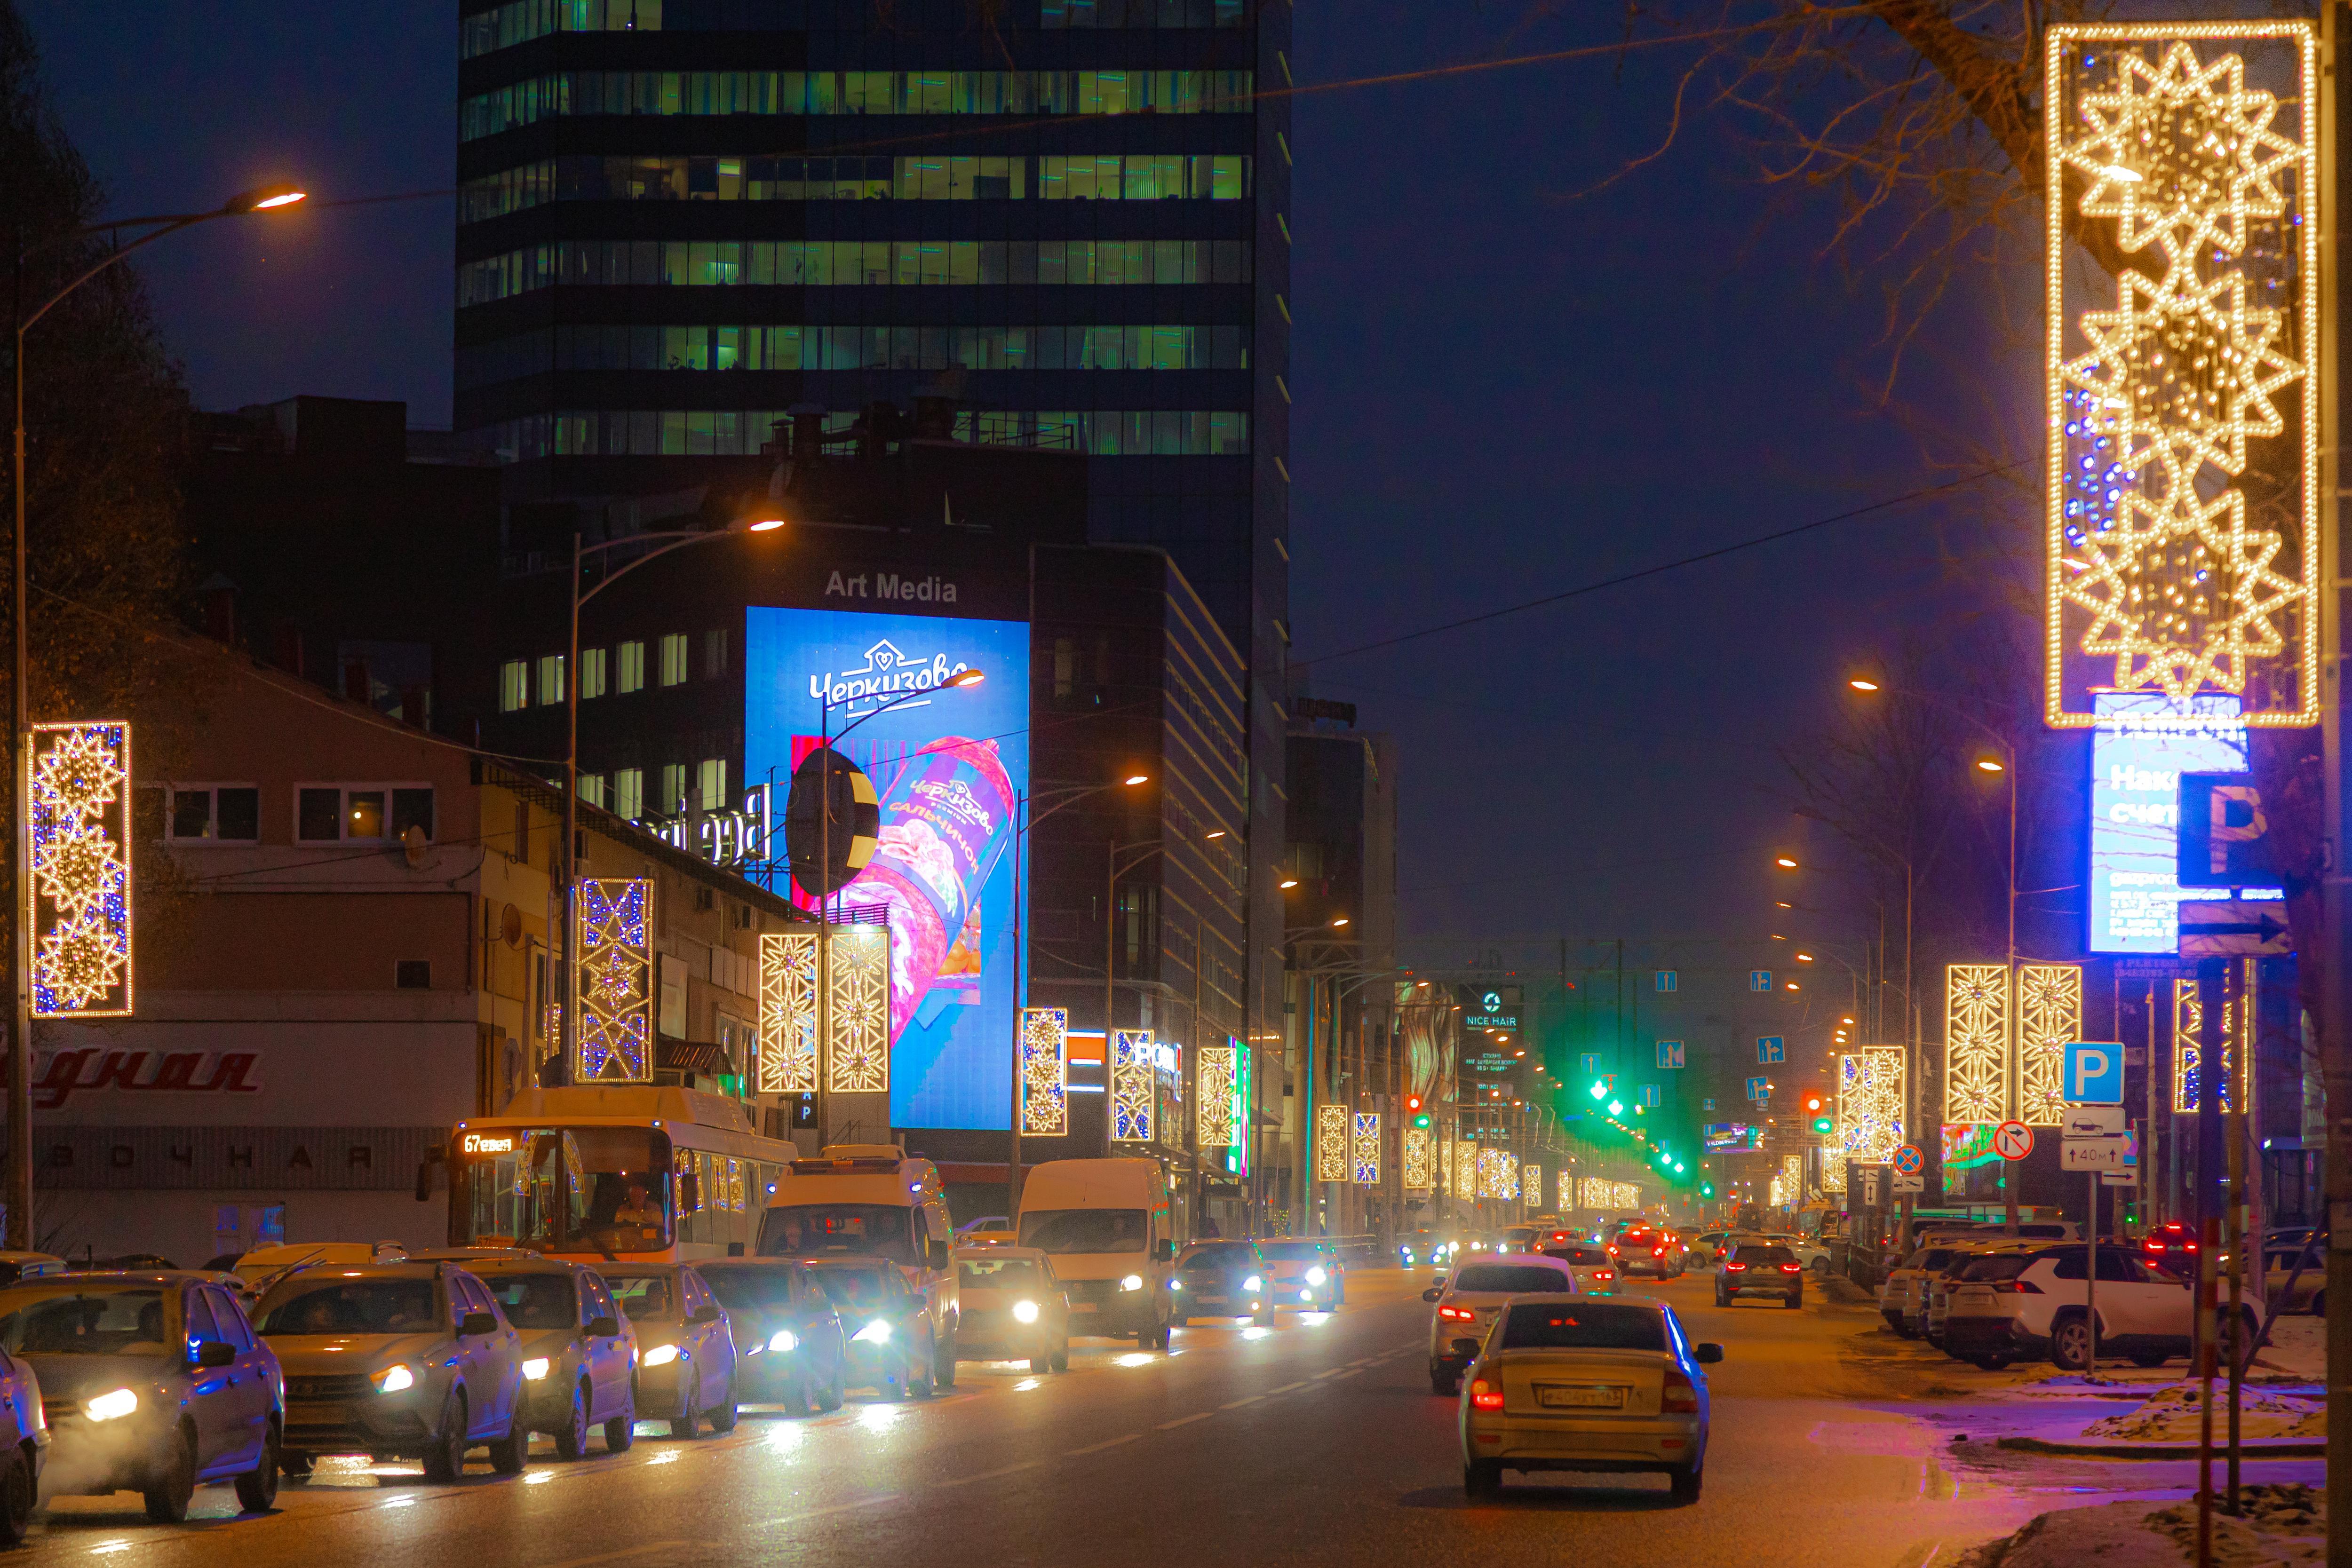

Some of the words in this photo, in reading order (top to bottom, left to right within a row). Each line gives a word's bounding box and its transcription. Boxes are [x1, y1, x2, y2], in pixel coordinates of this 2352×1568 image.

[825, 570, 867, 597] Art
[877, 573, 957, 602] Media
[910, 779, 994, 836] Черкизово
[2210, 786, 2268, 874] P
[889, 801, 979, 875] САЛЬЧИЧОН
[1467, 1016, 1489, 1025] NICE
[2076, 1049, 2109, 1096] P
